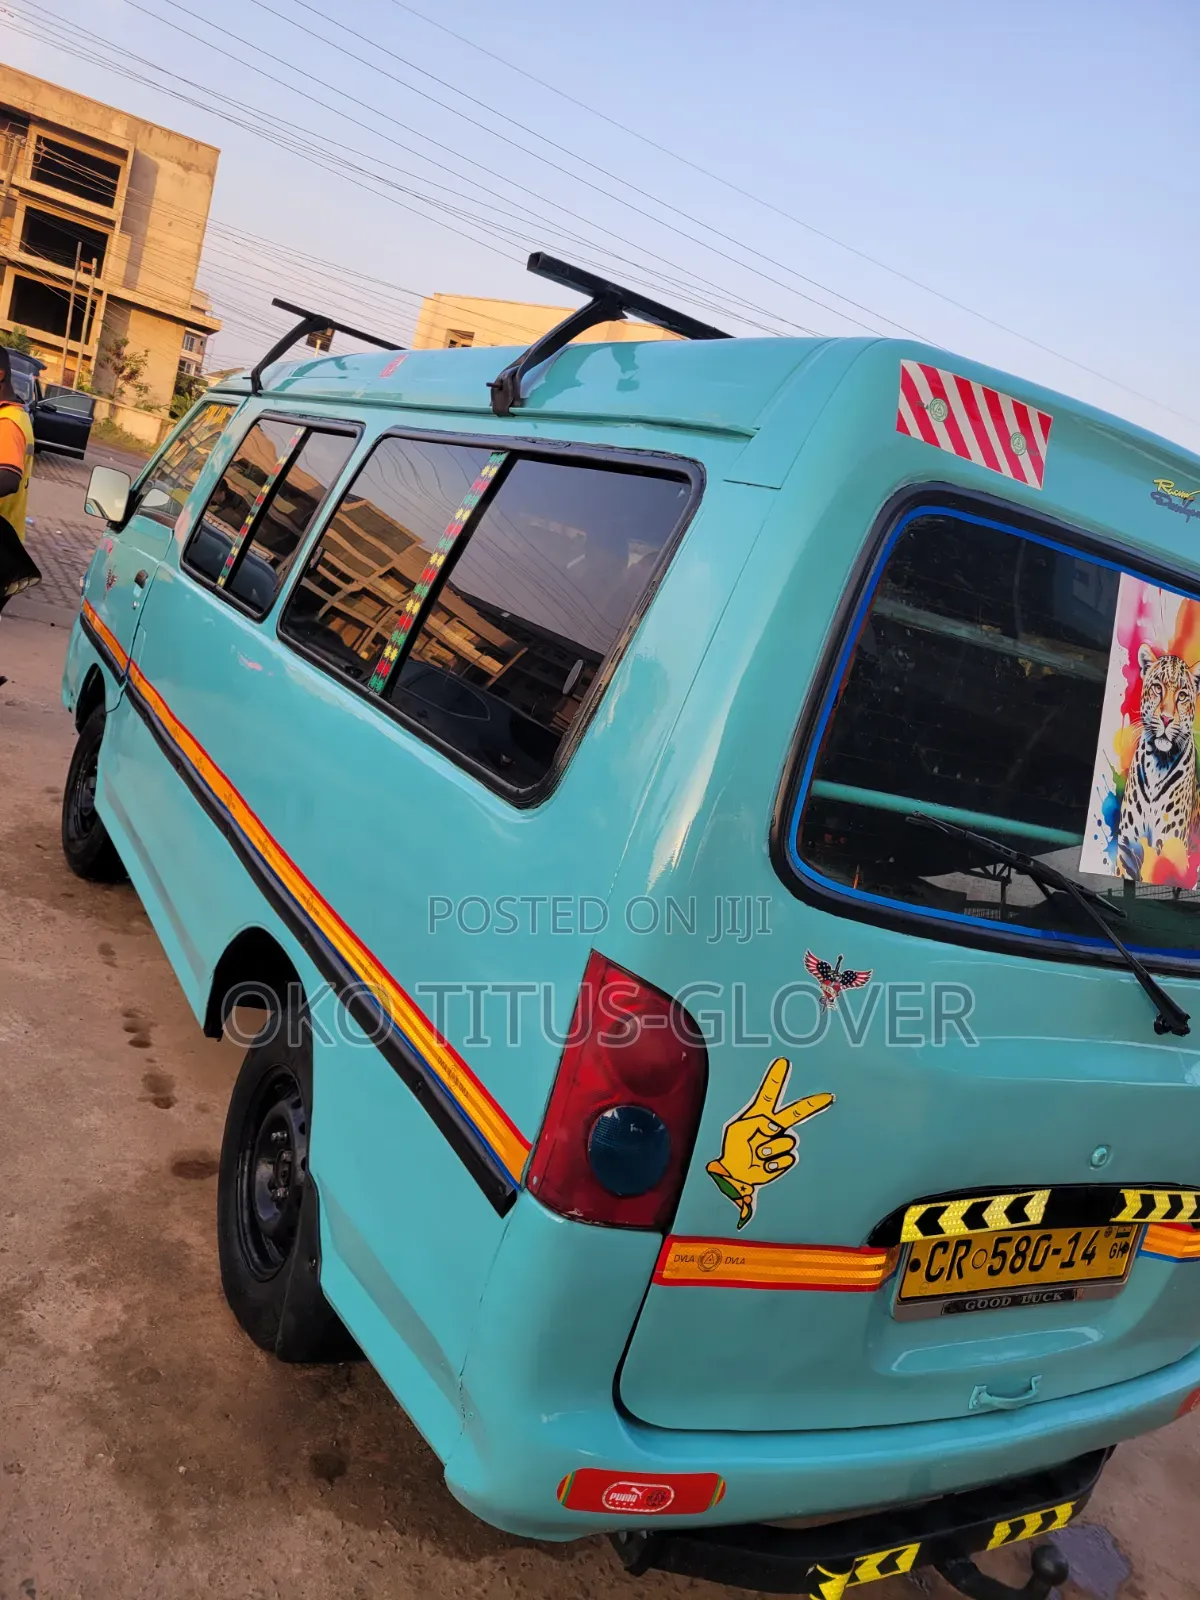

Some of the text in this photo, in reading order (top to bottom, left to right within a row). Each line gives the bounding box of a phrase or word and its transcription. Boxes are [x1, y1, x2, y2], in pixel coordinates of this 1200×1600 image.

[673, 1254, 746, 1265] DVLA DVLA
[924, 1230, 1100, 1283] CR 580-14
[965, 1296, 1012, 1311] GOOD
[609, 1492, 638, 1503] PUMA
